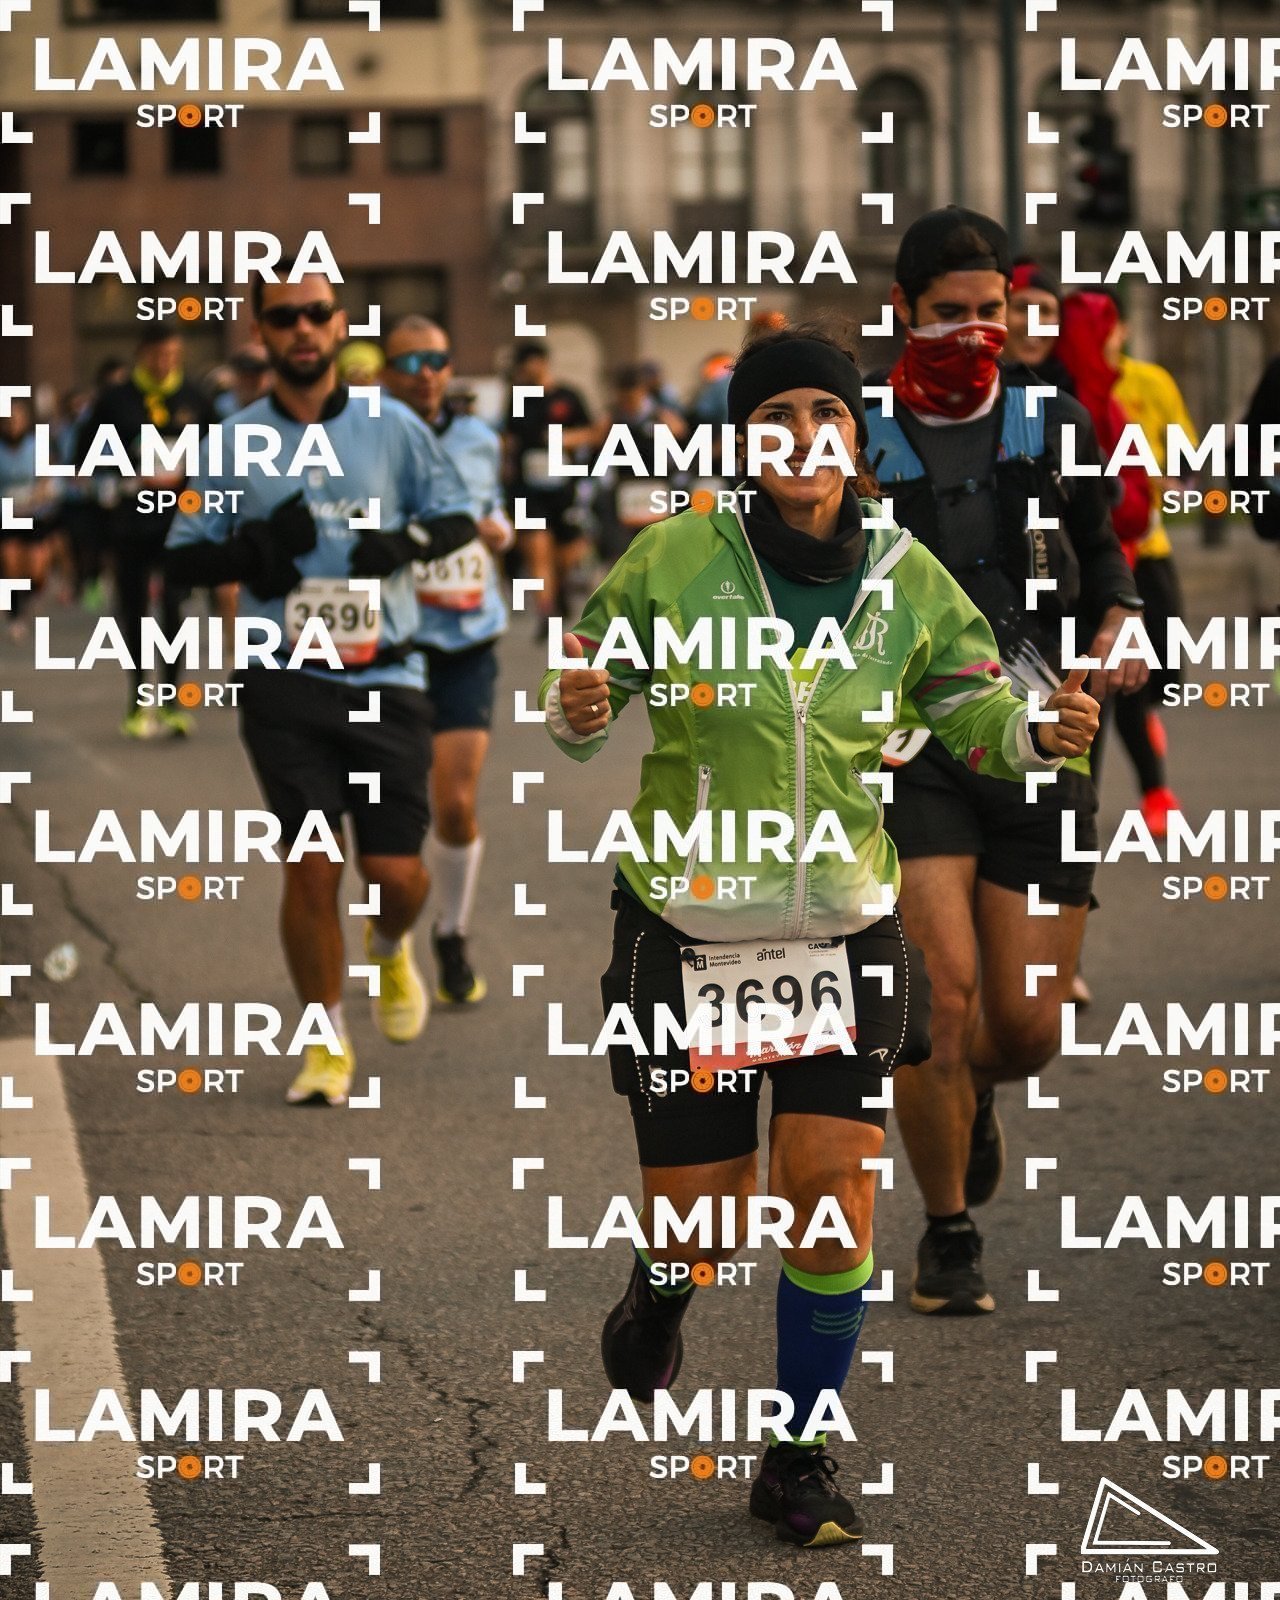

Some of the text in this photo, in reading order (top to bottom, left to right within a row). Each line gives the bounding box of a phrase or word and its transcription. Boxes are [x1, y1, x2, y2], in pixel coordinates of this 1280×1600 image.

[708, 952, 741, 961] Intendencia
[756, 947, 786, 962] antel
[709, 959, 742, 968] Montevideo
[697, 970, 842, 1027] 3696
